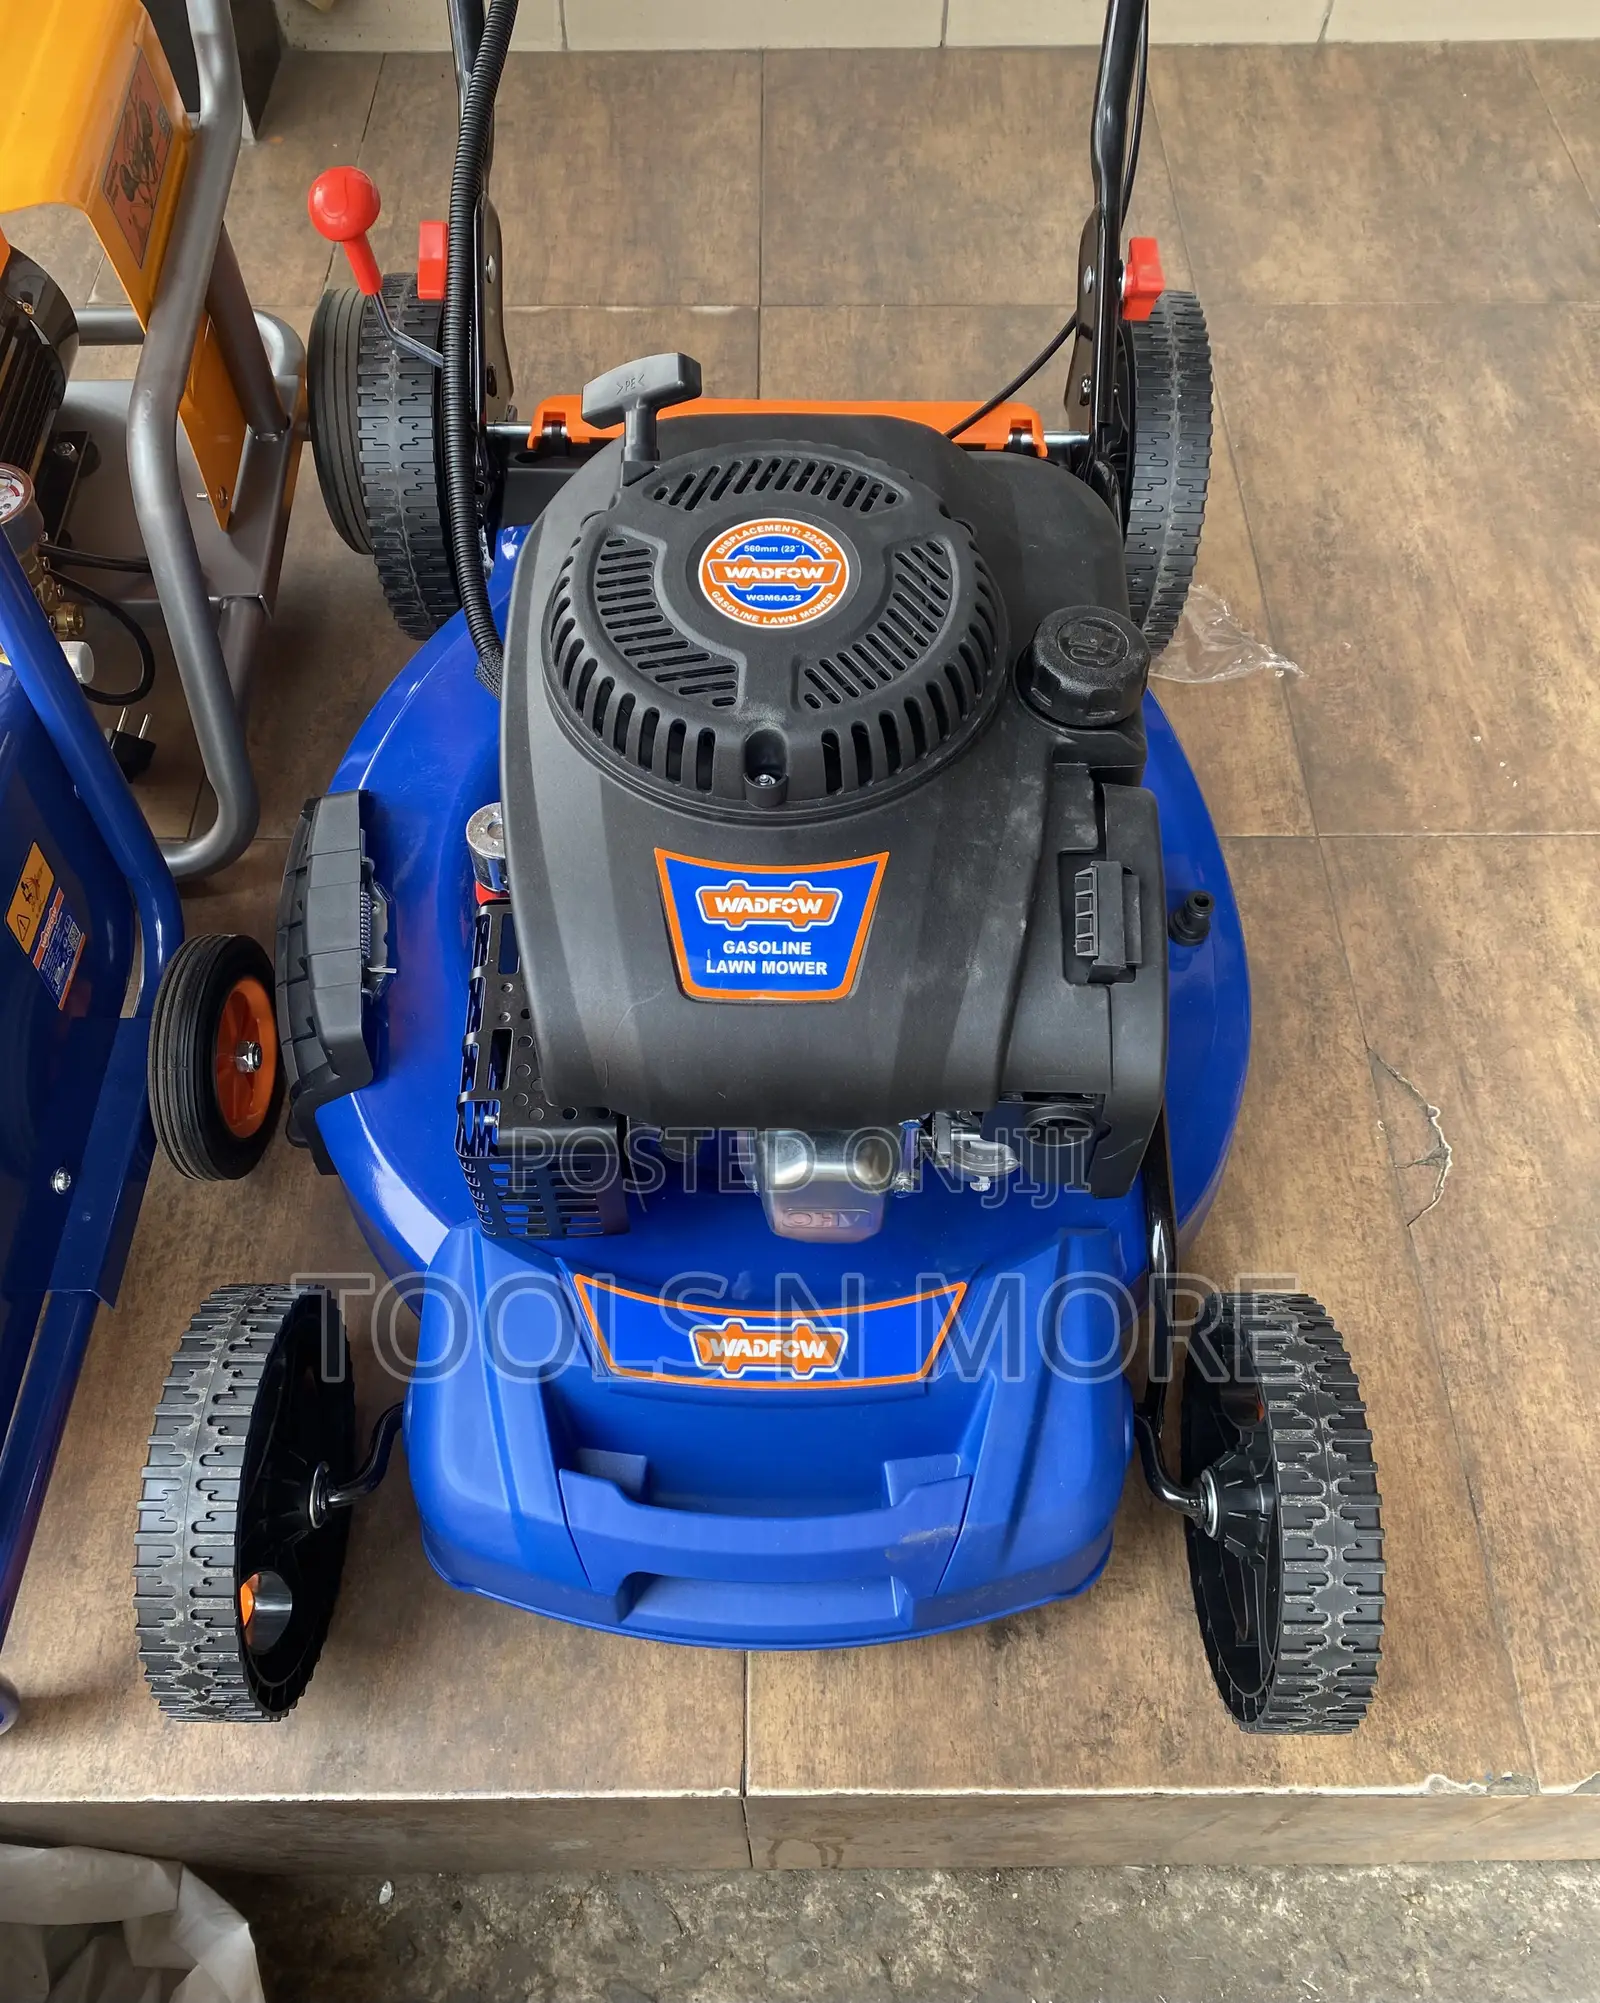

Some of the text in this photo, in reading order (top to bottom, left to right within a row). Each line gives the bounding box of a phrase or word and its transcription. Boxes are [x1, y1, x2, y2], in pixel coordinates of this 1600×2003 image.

[716, 524, 833, 555] DISPLACEMENT: 224CC
[744, 545, 778, 553] 560mm
[723, 566, 825, 579] WADFOW
[746, 594, 802, 602] WGM6A22
[711, 591, 836, 625] GASOLINE LAWN MOWER
[715, 897, 823, 914] WADFOW
[723, 940, 812, 955] GASOLINE
[706, 959, 828, 975] LAWN MOWER
[709, 1338, 828, 1359] WADFOW
